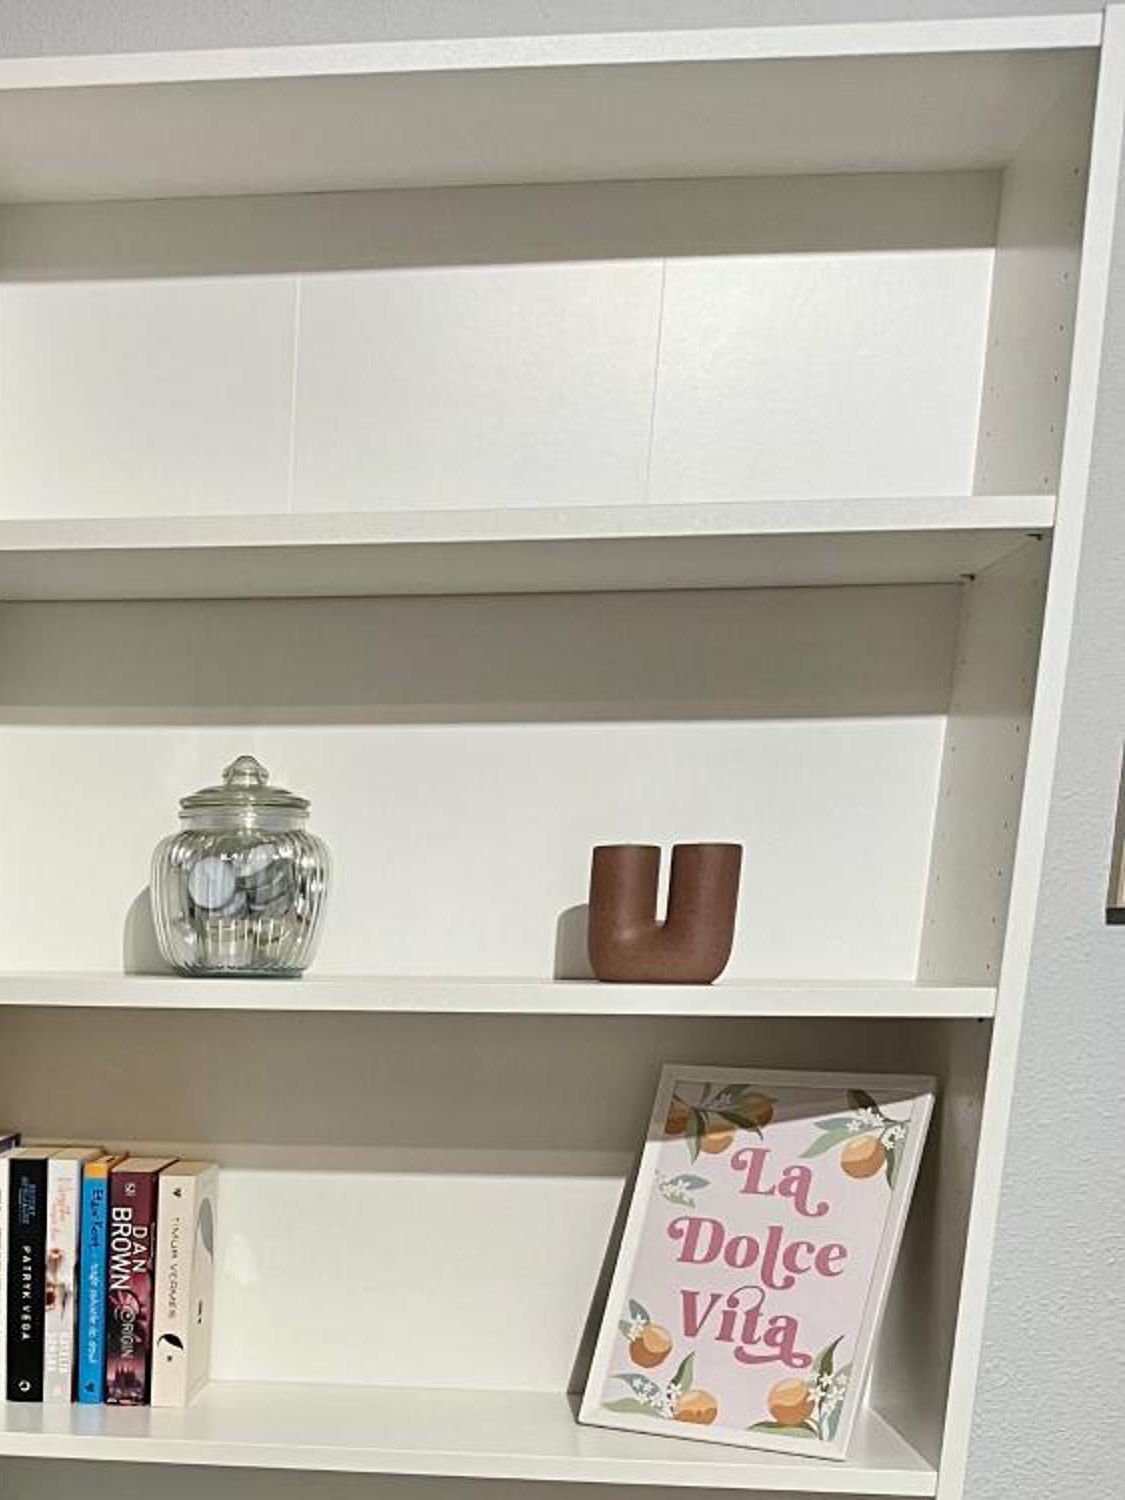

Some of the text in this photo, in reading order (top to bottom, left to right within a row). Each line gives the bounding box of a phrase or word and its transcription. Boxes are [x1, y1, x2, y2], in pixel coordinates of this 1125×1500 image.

[730, 1147, 829, 1217] La
[110, 1207, 132, 1290] BROWN
[132, 1226, 148, 1273] DAN
[667, 1216, 848, 1290] Dolce
[21, 1245, 32, 1341] PATRYK VEGA
[681, 1285, 813, 1369] Vita
[119, 1304, 135, 1359] ORIGIN
